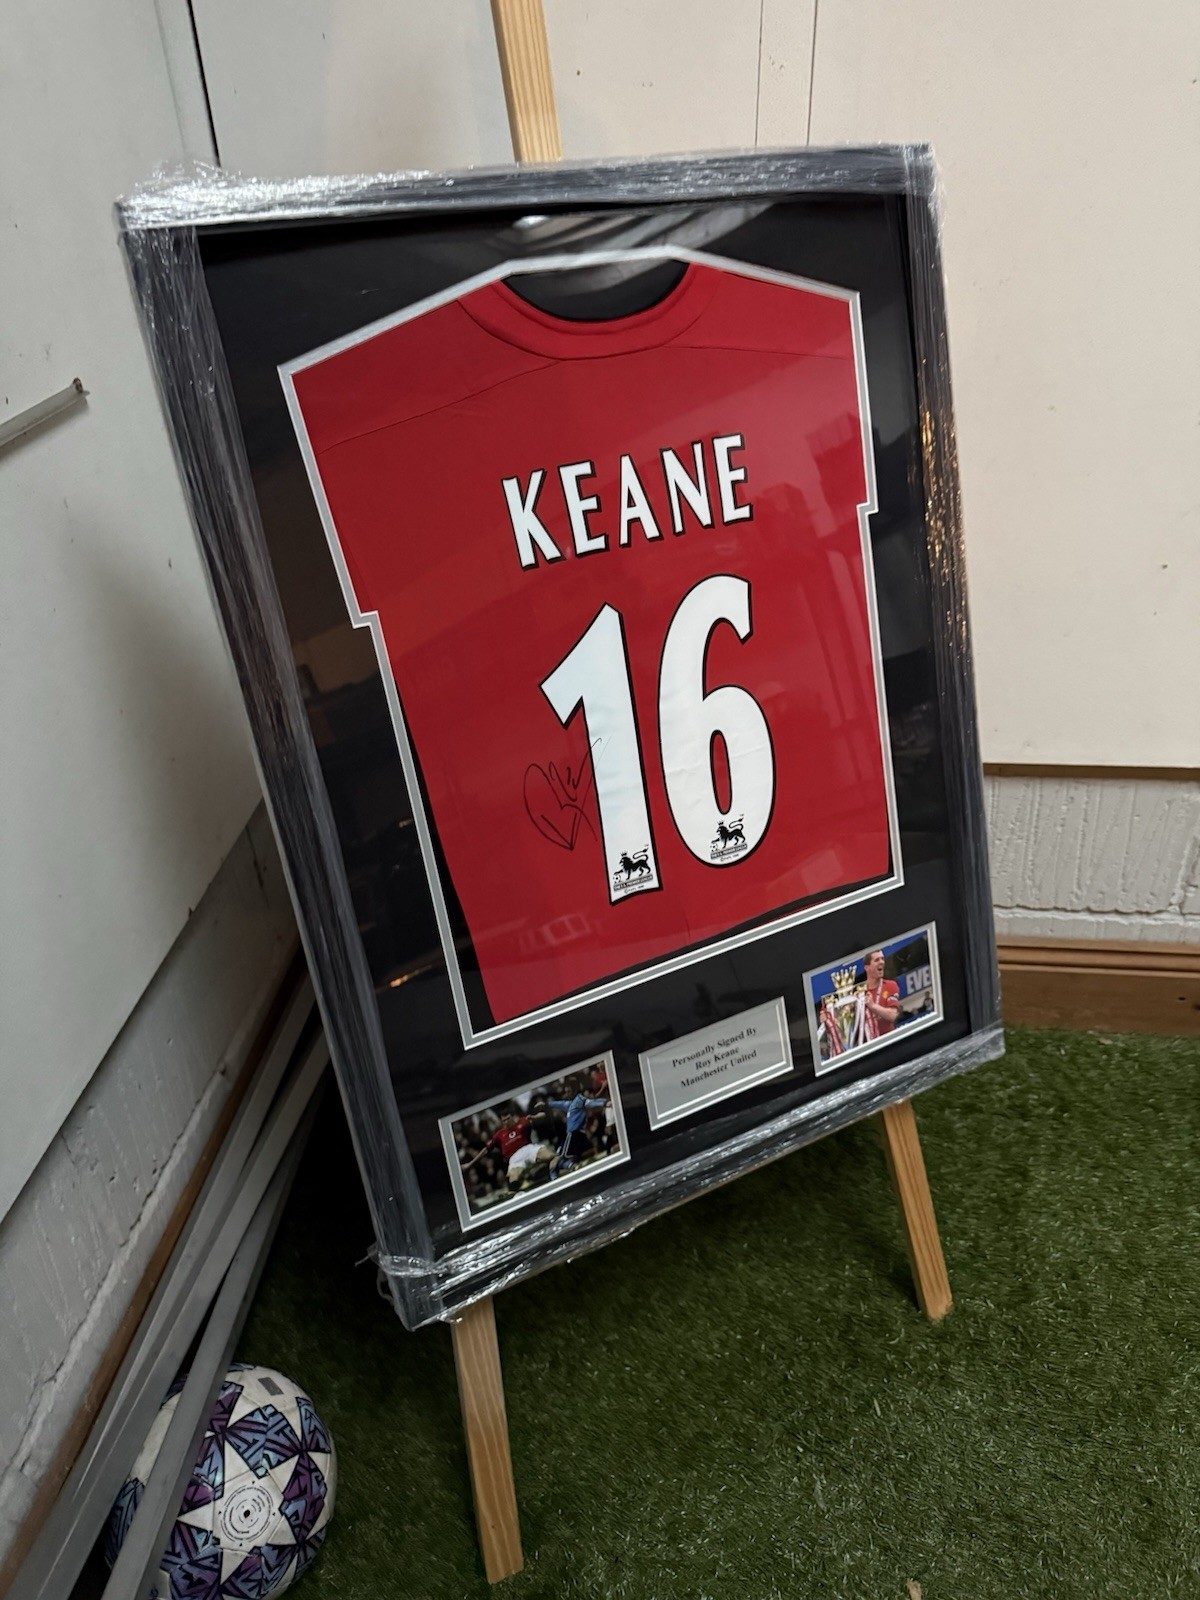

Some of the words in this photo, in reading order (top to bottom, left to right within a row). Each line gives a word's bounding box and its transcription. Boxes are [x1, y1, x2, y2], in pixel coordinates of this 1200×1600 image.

[501, 433, 753, 572] KEANE
[538, 573, 777, 906] 16
[906, 965, 932, 995] EVE
[672, 1044, 715, 1068] Personally
[717, 1031, 745, 1048] Signed
[746, 1027, 757, 1037] By
[695, 1059, 711, 1071] Roy
[713, 1047, 740, 1063] Keane
[680, 1063, 728, 1088] Manchester
[730, 1049, 757, 1068] United
